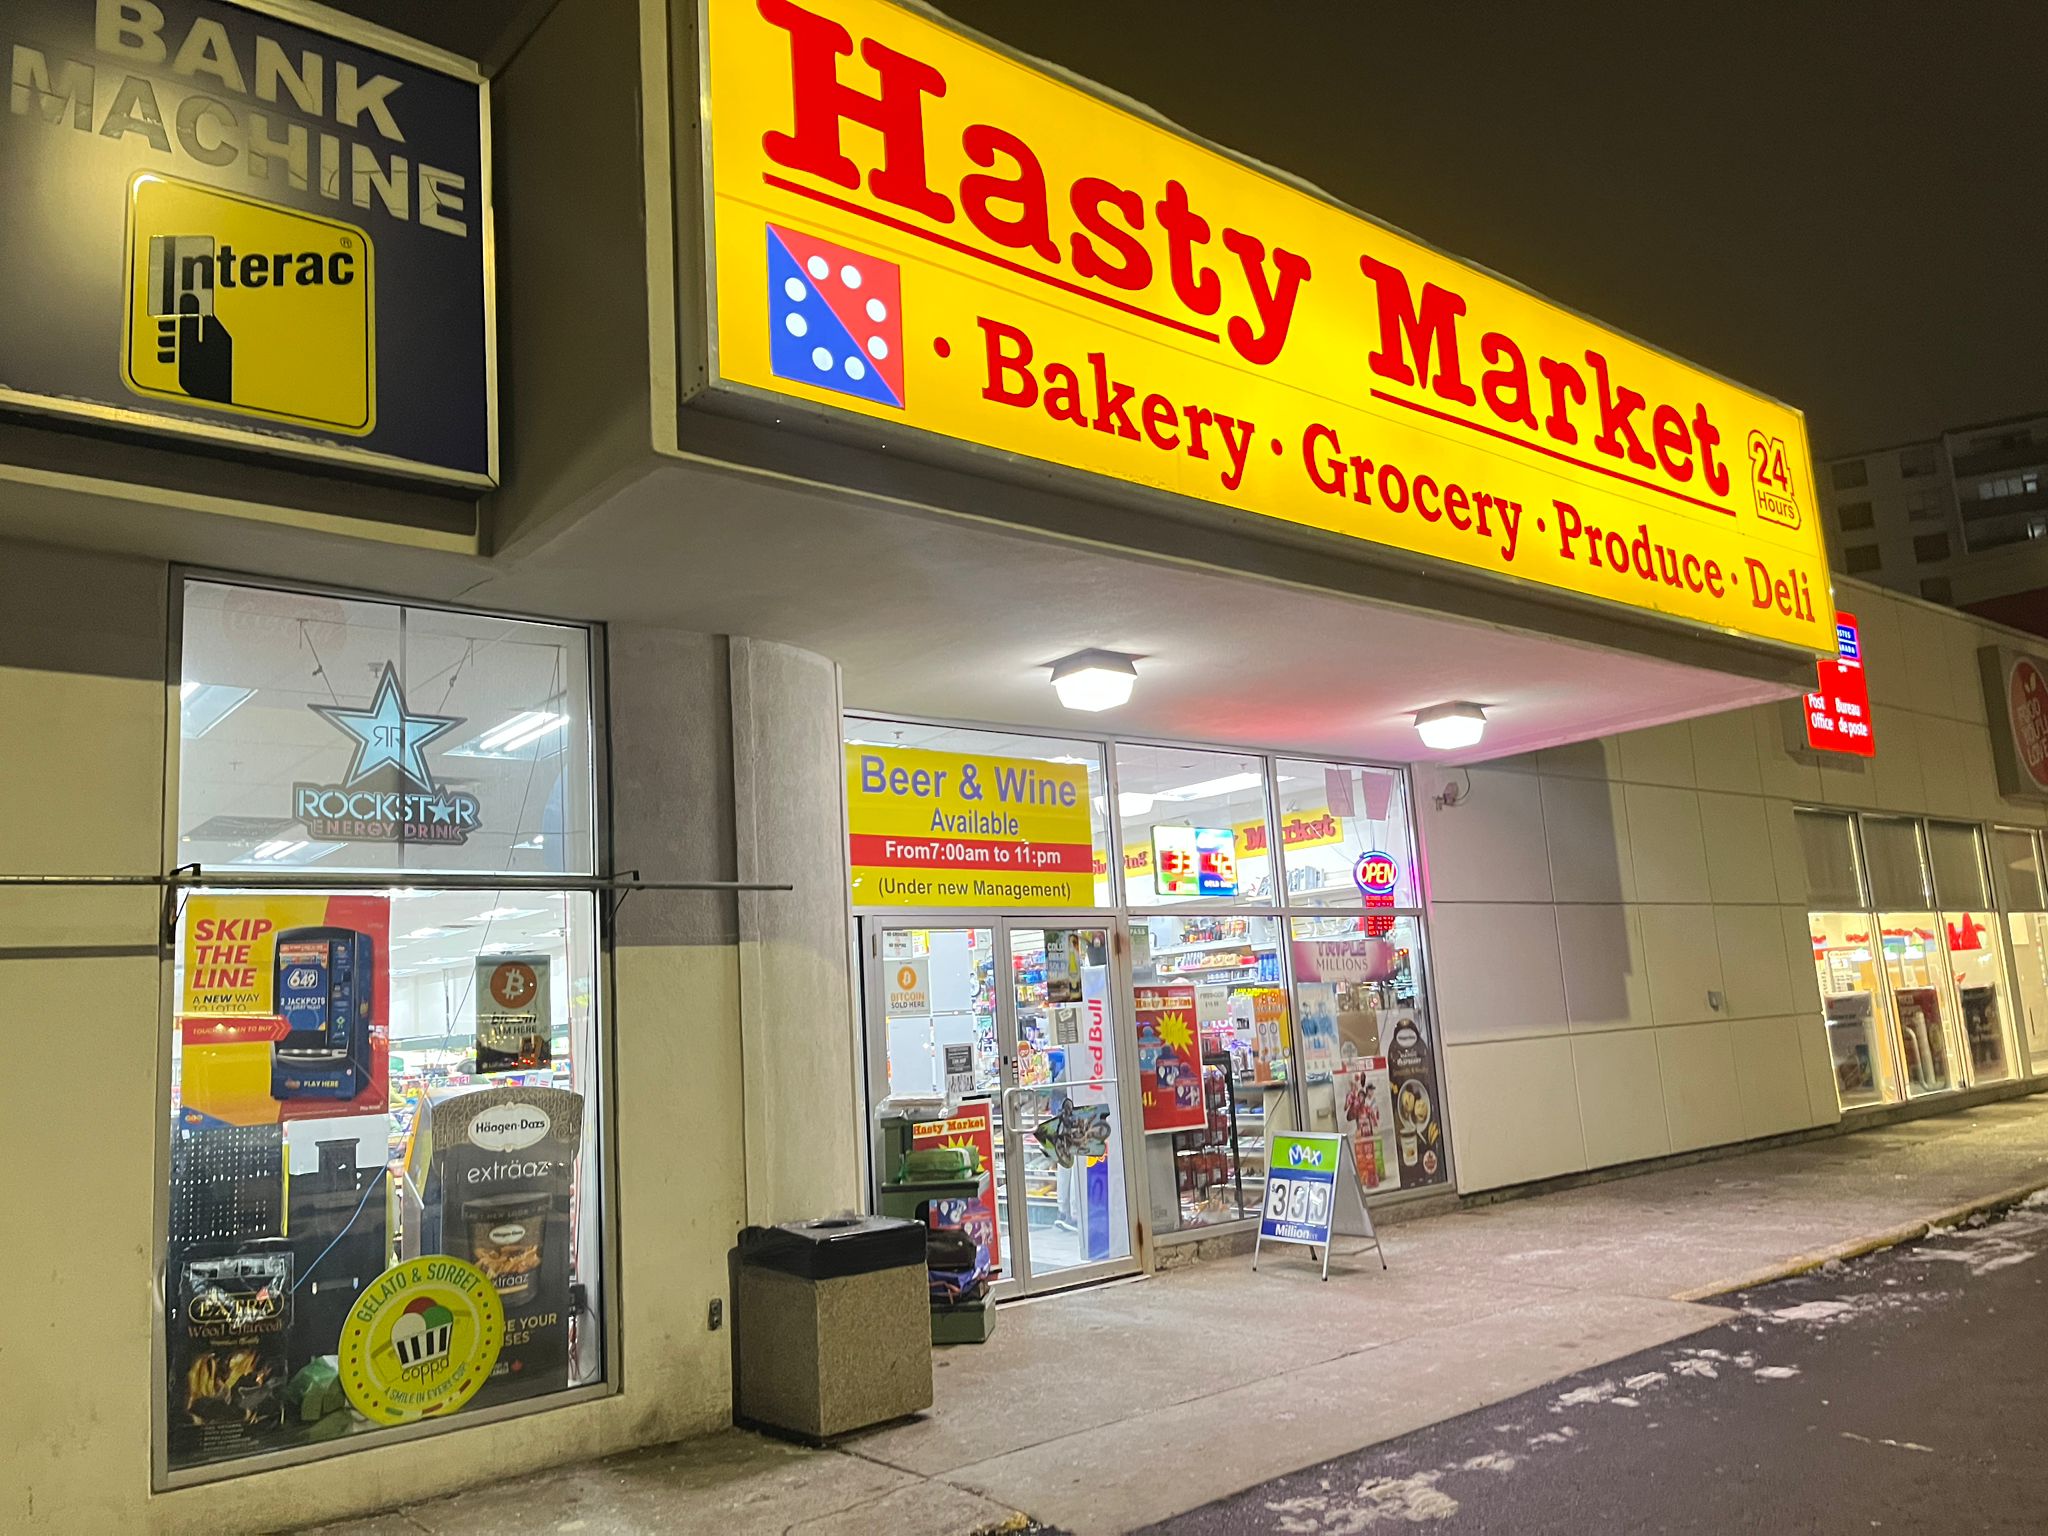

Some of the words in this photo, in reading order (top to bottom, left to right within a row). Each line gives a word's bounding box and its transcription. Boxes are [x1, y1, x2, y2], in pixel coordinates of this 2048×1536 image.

[94, 0, 406, 143] BANK
[10, 43, 467, 238] MACHINE
[756, 0, 1312, 366] Hasty
[1360, 254, 1730, 498] Market
[976, 315, 1256, 491] Bakery
[1302, 423, 1522, 562] Grocery
[1552, 499, 1725, 599] Produce
[1743, 556, 1816, 624] Deli
[1753, 441, 1788, 492] 24
[1757, 489, 1795, 519] Hours
[1808, 693, 1826, 710] Post
[1834, 697, 1861, 717] Bureau
[1810, 711, 1834, 731] Office
[1838, 717, 1849, 733] de
[1848, 722, 1868, 738] poste
[860, 755, 947, 798] Beer
[958, 763, 983, 800] &
[993, 766, 1077, 807] Wine
[313, 820, 395, 836] ENERGY
[404, 824, 462, 841] DRINK
[931, 807, 1020, 836] Available
[994, 846, 1010, 863] to
[1014, 847, 1061, 867] 11:pm
[1360, 862, 1395, 884] OPEN
[878, 877, 932, 898] (Under
[938, 880, 969, 895] new
[973, 879, 1071, 900] Management)
[194, 918, 273, 941] SKIP
[194, 944, 252, 965] THE
[1316, 957, 1369, 971] MILLIONS
[191, 967, 258, 989] LINE
[193, 995, 200, 1004] A
[203, 994, 232, 1003] NEW
[235, 993, 260, 1002] WAY
[891, 1001, 908, 1009] SOLD
[513, 1025, 536, 1034] HERE
[1088, 998, 1103, 1042] Bull
[946, 1118, 984, 1131] Market
[1288, 1144, 1322, 1167] MAX
[1275, 1223, 1310, 1240] Million
[356, 1271, 407, 1323] GELATO
[411, 1267, 422, 1283] &
[426, 1262, 482, 1294] SORBET
[519, 1312, 557, 1330] YOUR
[401, 1358, 449, 1386] coppa
